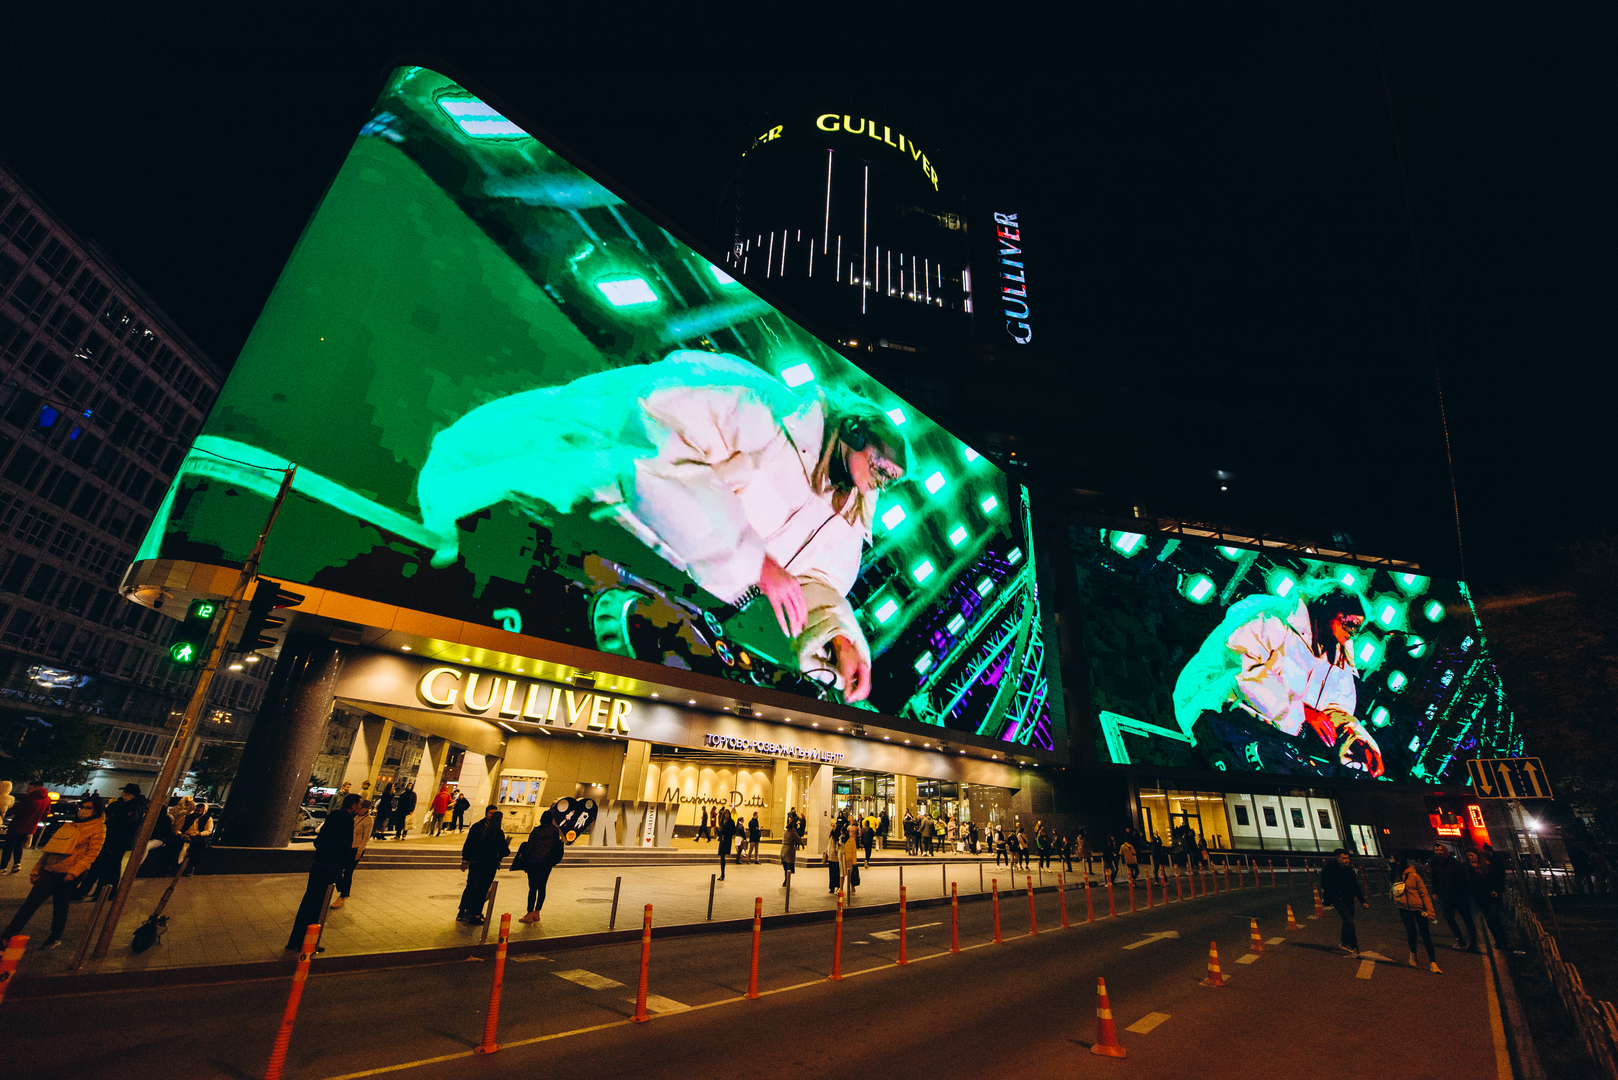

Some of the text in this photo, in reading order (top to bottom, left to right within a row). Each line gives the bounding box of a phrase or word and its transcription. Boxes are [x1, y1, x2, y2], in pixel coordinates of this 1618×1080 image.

[816, 113, 939, 192] GULLIVER
[994, 211, 1032, 345] GULLIVER
[198, 605, 213, 618] 12
[419, 666, 634, 733] GULLIVER
[706, 733, 845, 763] ТОРГОВО-РОЗВАЖАЛЬНИЙ ЦЕНТР
[663, 787, 766, 808] Massimo Dutti
[588, 799, 680, 848] KYIV
